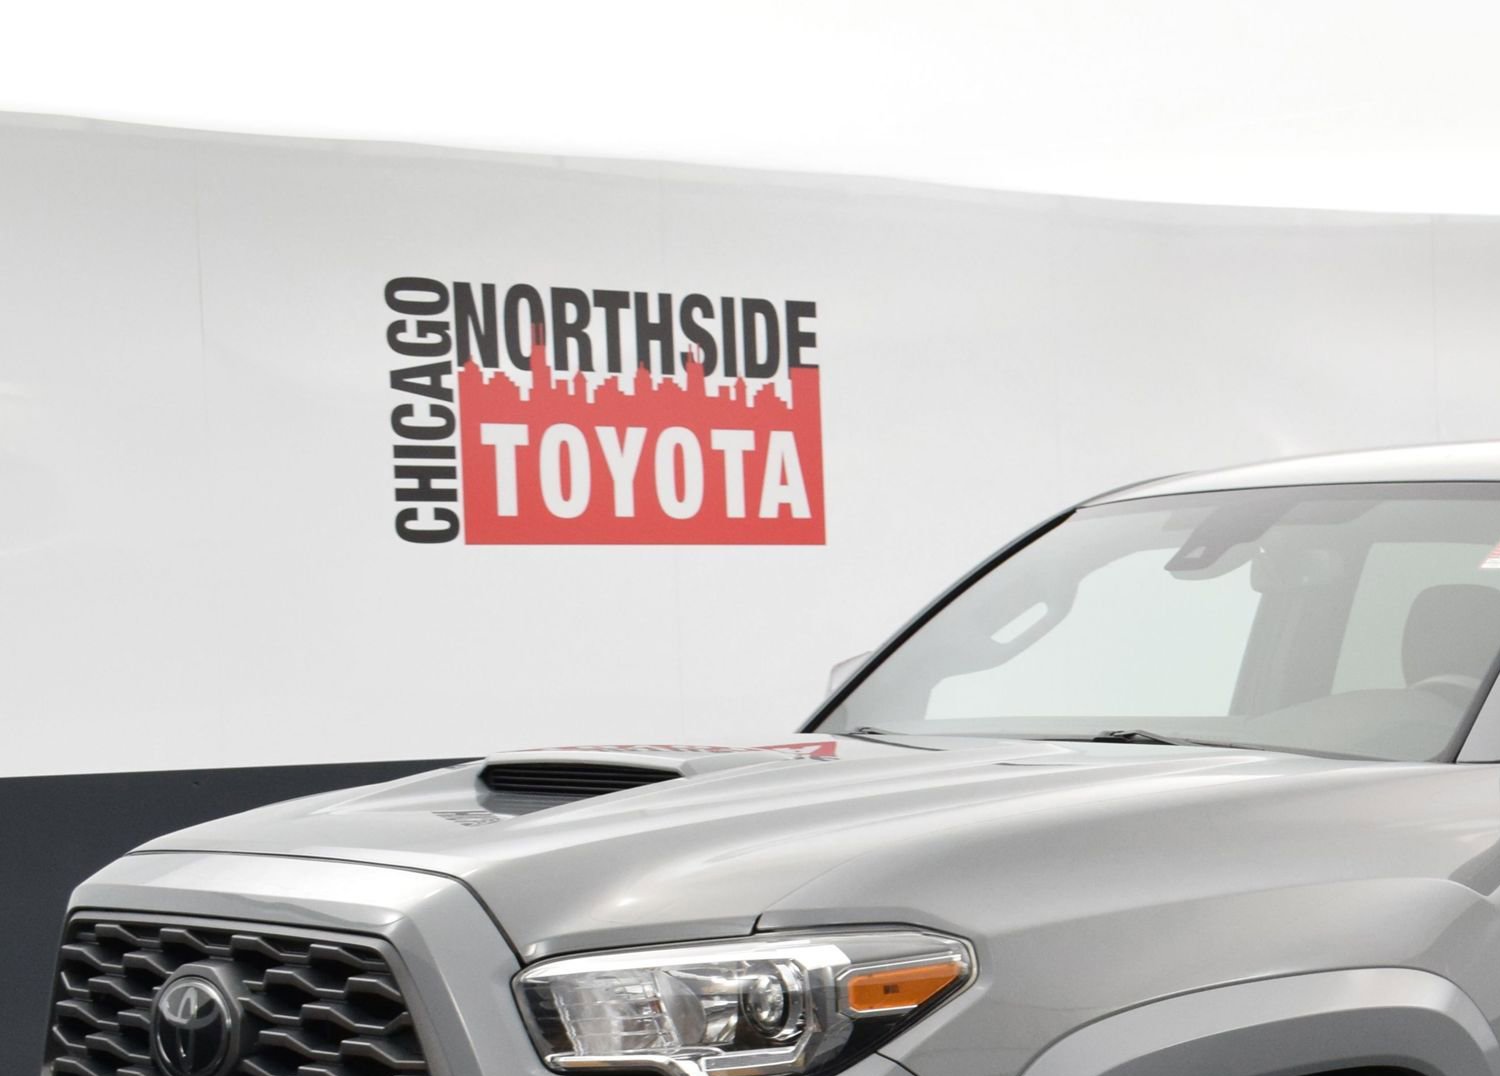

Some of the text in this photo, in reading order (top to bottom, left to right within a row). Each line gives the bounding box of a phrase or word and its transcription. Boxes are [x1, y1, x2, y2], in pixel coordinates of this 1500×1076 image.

[453, 281, 819, 379] NORTHSIDE
[384, 276, 460, 544] CHICAGO
[480, 422, 812, 519] TOYOTA
